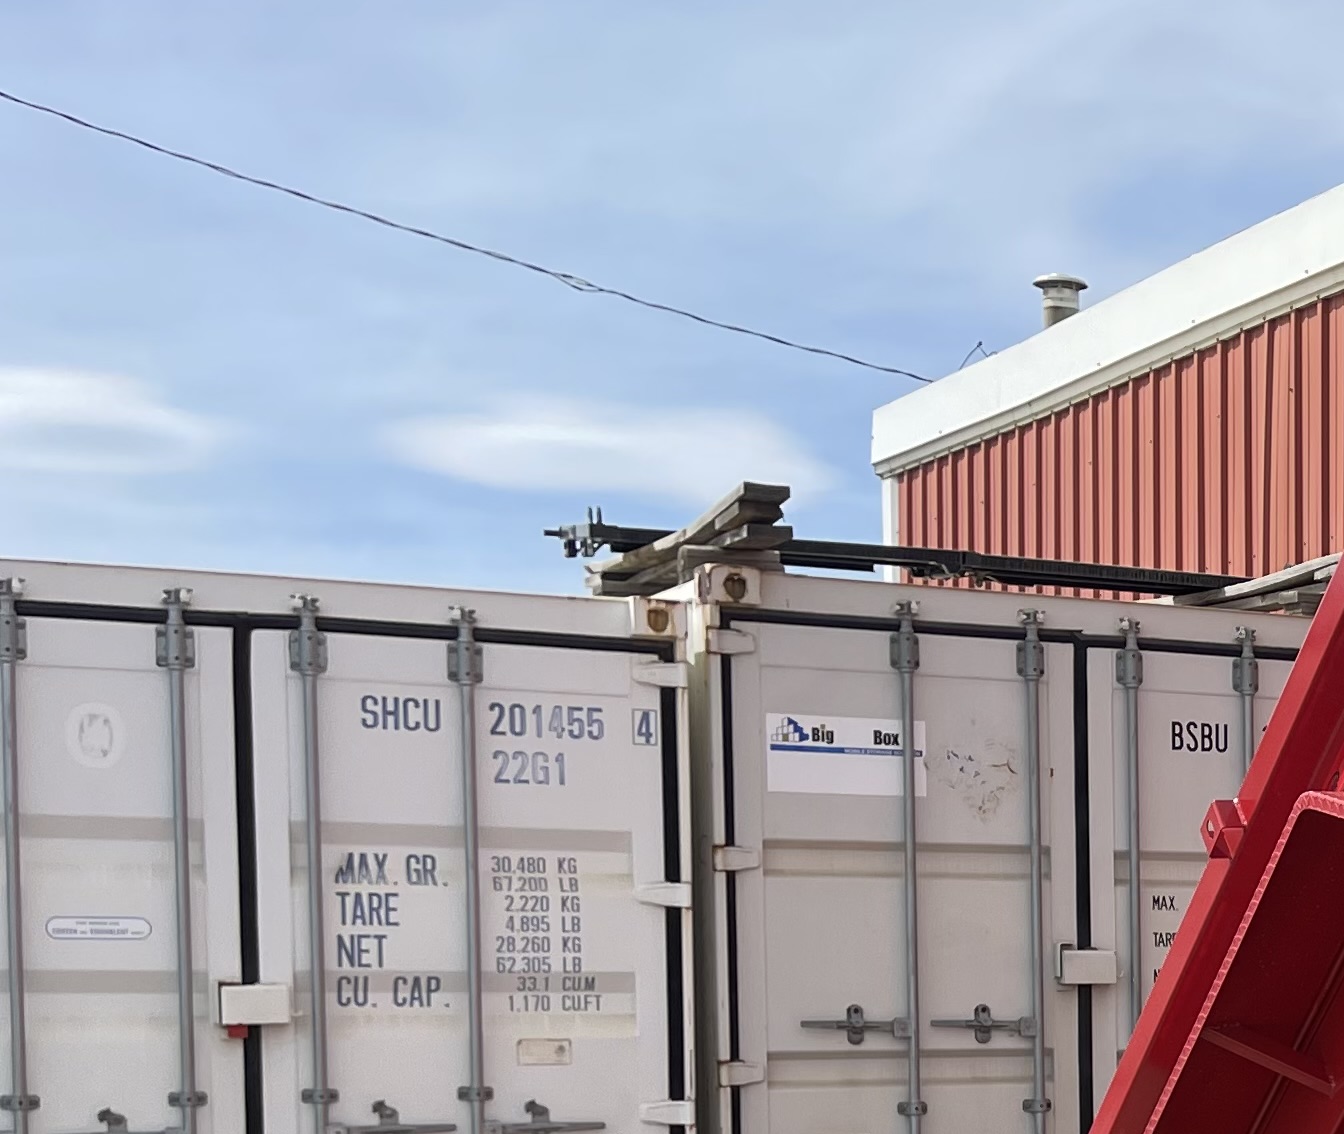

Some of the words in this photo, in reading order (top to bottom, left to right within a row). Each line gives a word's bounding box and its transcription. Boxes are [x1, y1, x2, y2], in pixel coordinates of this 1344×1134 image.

[360, 695, 441, 732] SHCU
[489, 702, 605, 740] 201455
[636, 711, 655, 744] 4
[811, 724, 835, 745] Big
[873, 729, 900, 746] Box
[1171, 721, 1229, 753] BSBU
[492, 750, 566, 786] 22G1
[334, 852, 398, 886] MAX.
[405, 854, 449, 888] GR.
[557, 857, 577, 875] KG
[559, 877, 579, 893] LB
[335, 892, 400, 927] TARE
[560, 896, 580, 913] KG
[1152, 895, 1179, 911] MAX.
[561, 916, 581, 933] LB
[336, 934, 388, 969] NET
[495, 936, 551, 954] 28.260
[562, 936, 582, 954] KG
[496, 956, 551, 974] 62.305
[563, 957, 582, 974] LB
[336, 975, 378, 1008] CU.
[393, 975, 450, 1009] CAP.
[516, 976, 550, 993] 33.1
[508, 995, 551, 1012] 1.170
